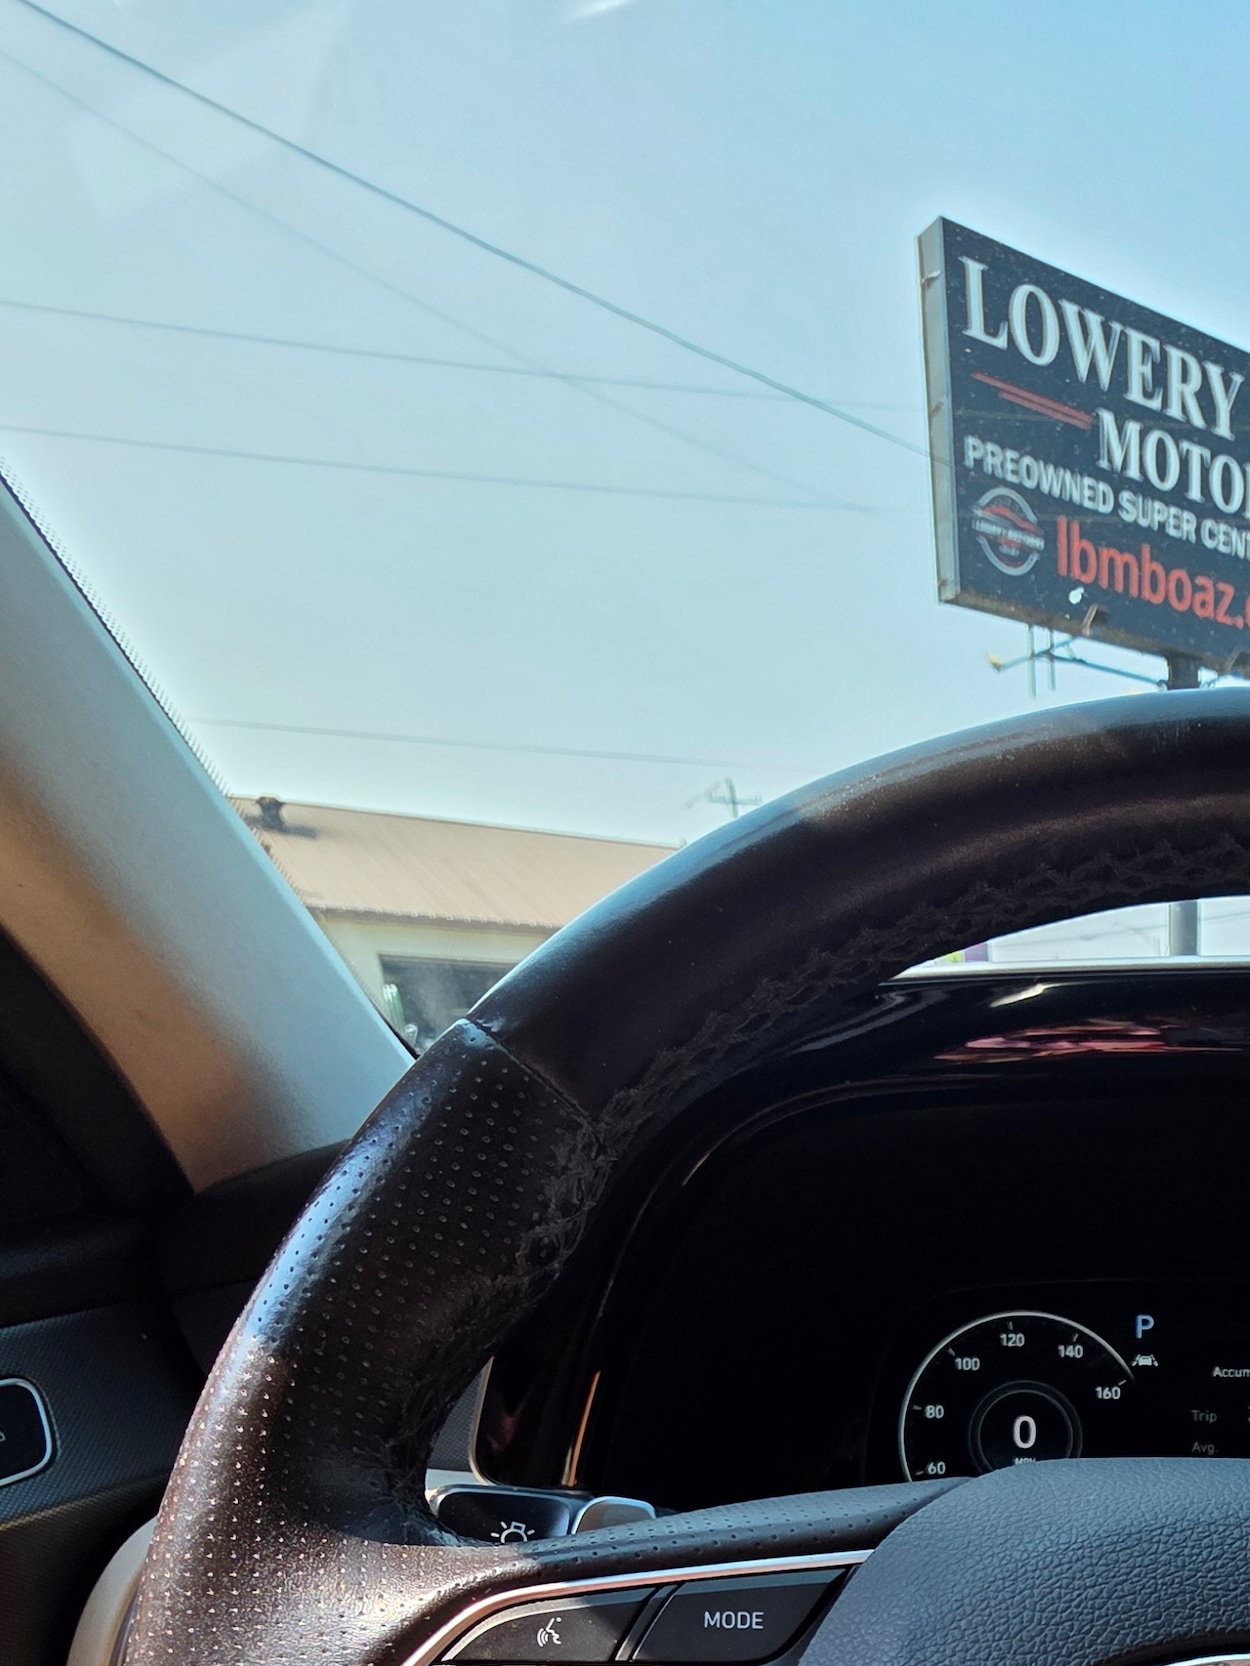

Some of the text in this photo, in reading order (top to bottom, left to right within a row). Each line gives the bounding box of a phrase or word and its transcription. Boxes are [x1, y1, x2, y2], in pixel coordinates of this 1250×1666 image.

[960, 256, 1244, 440] LOWERY
[964, 435, 1115, 514] PREOWNED
[1118, 489, 1197, 544] SUPER
[1135, 1315, 1154, 1339] P
[1000, 1333, 1025, 1347] 120
[1058, 1345, 1083, 1359] 140
[955, 1357, 980, 1371] 100
[1095, 1386, 1121, 1400] 160
[925, 1405, 944, 1419] 80
[1191, 1410, 1217, 1423] Trip
[1013, 1415, 1037, 1449] 0
[1191, 1441, 1219, 1455] Avg.
[927, 1461, 946, 1475] 60
[703, 1610, 765, 1630] MODE
